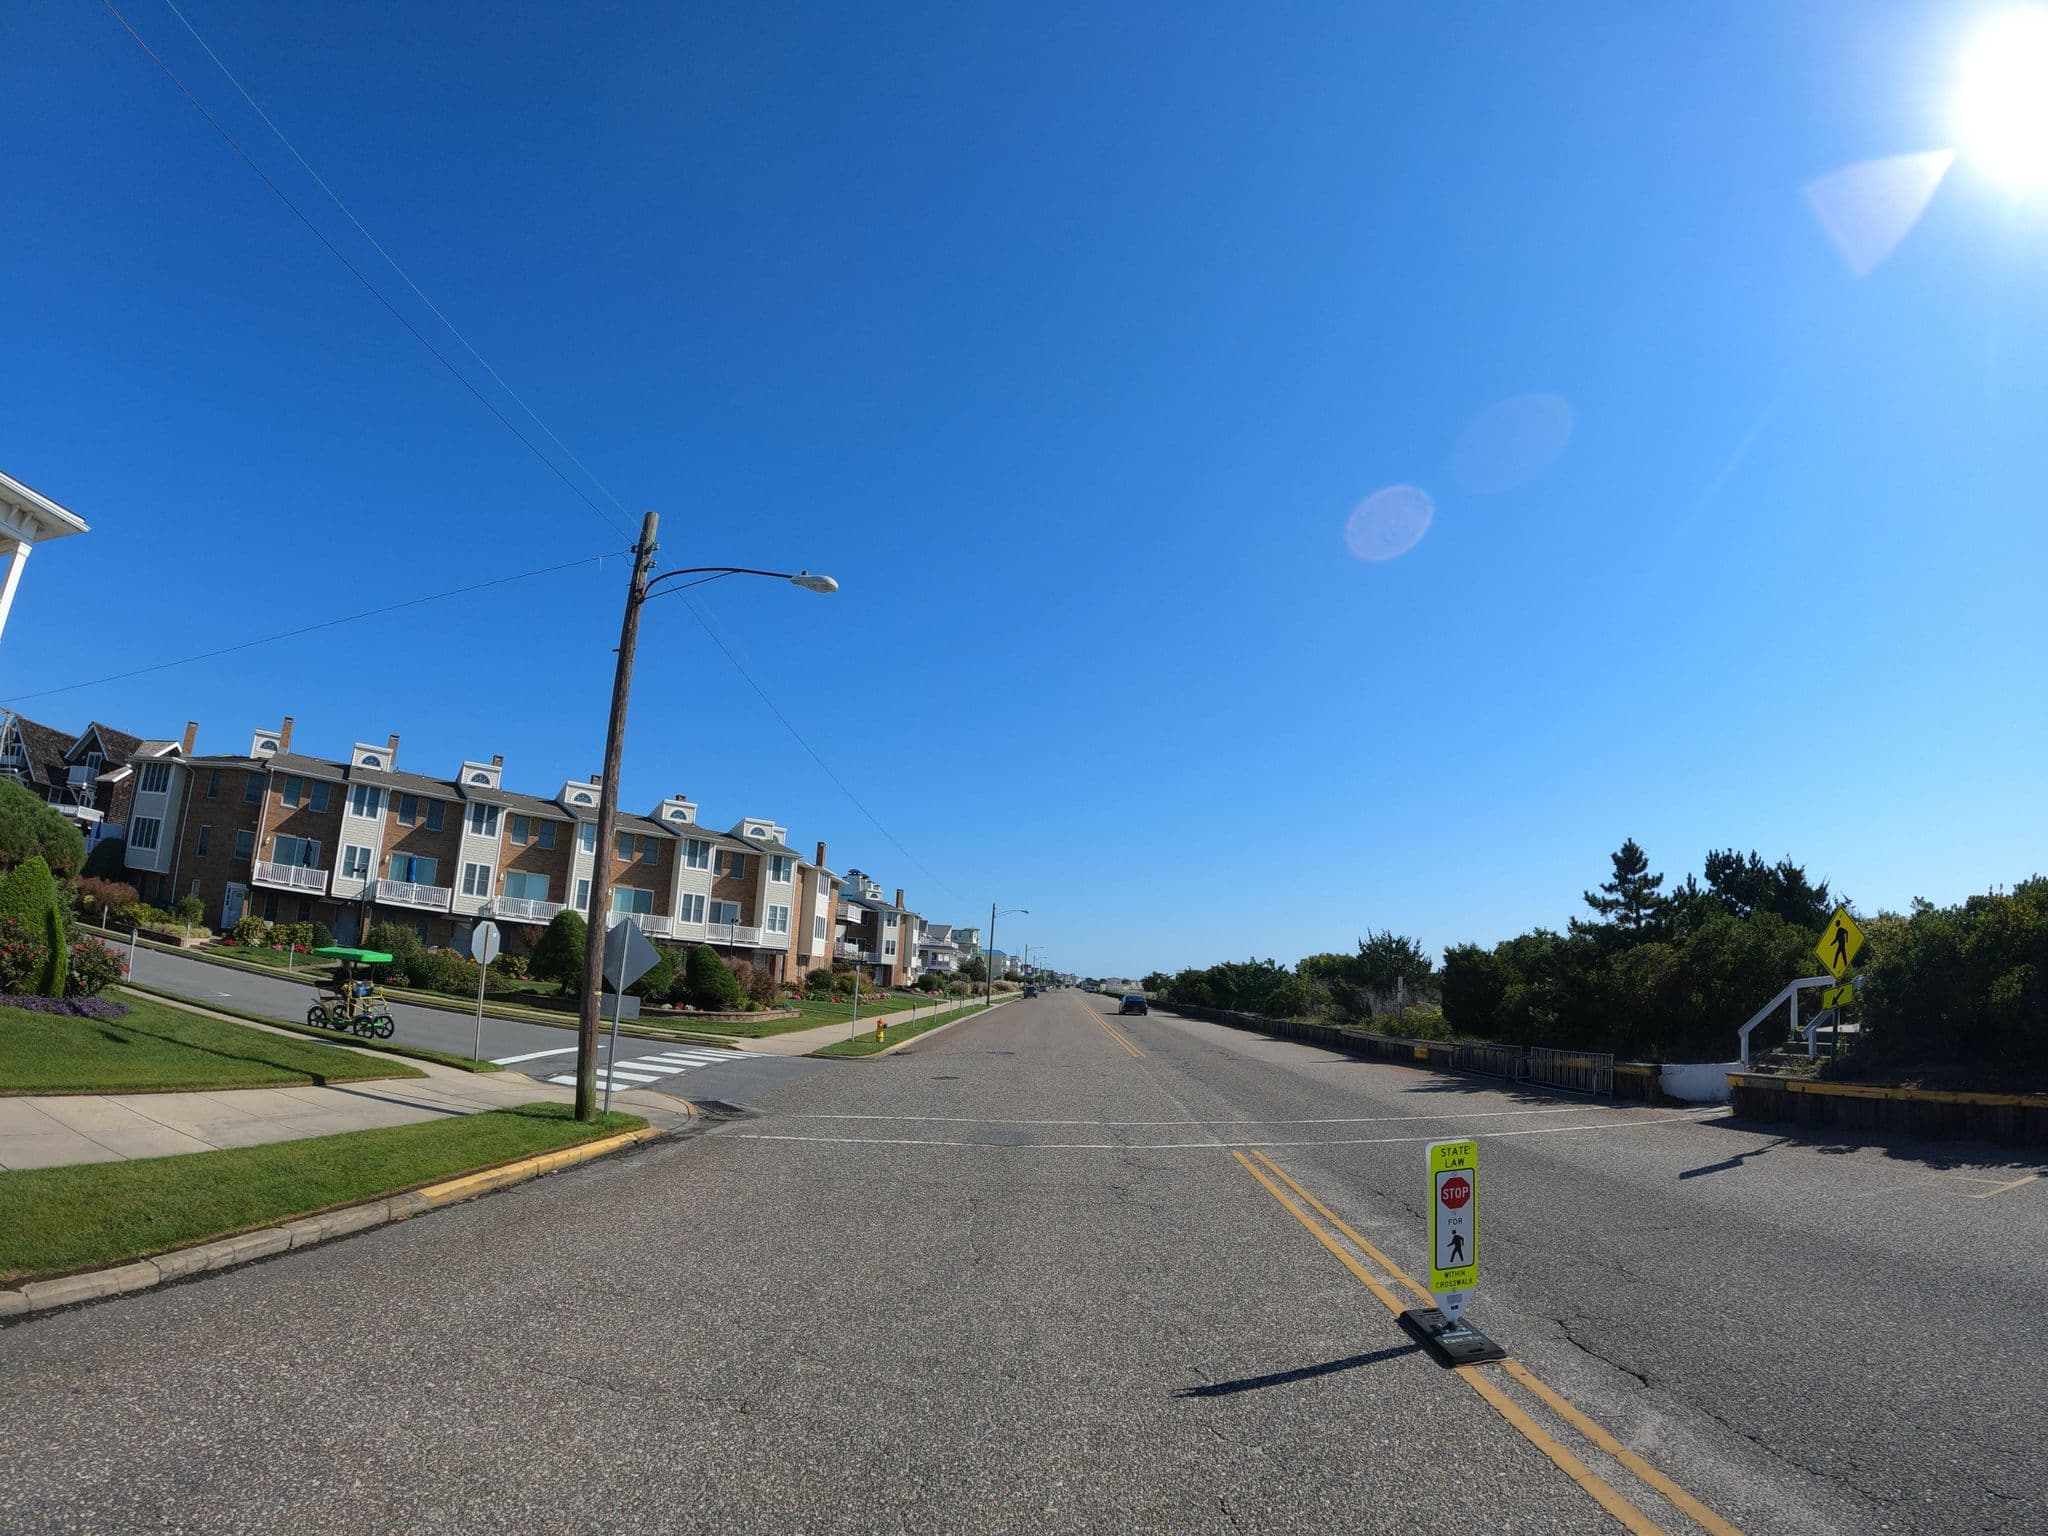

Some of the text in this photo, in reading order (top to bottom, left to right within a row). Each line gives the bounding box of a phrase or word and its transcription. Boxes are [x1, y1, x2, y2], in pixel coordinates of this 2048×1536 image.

[1441, 1146, 1470, 1157] STATE
[1445, 1158, 1465, 1168] LAW
[1442, 1187, 1469, 1200] STOP
[1448, 1217, 1463, 1226] FOR
[1435, 1278, 1473, 1288] CROSSWALK
